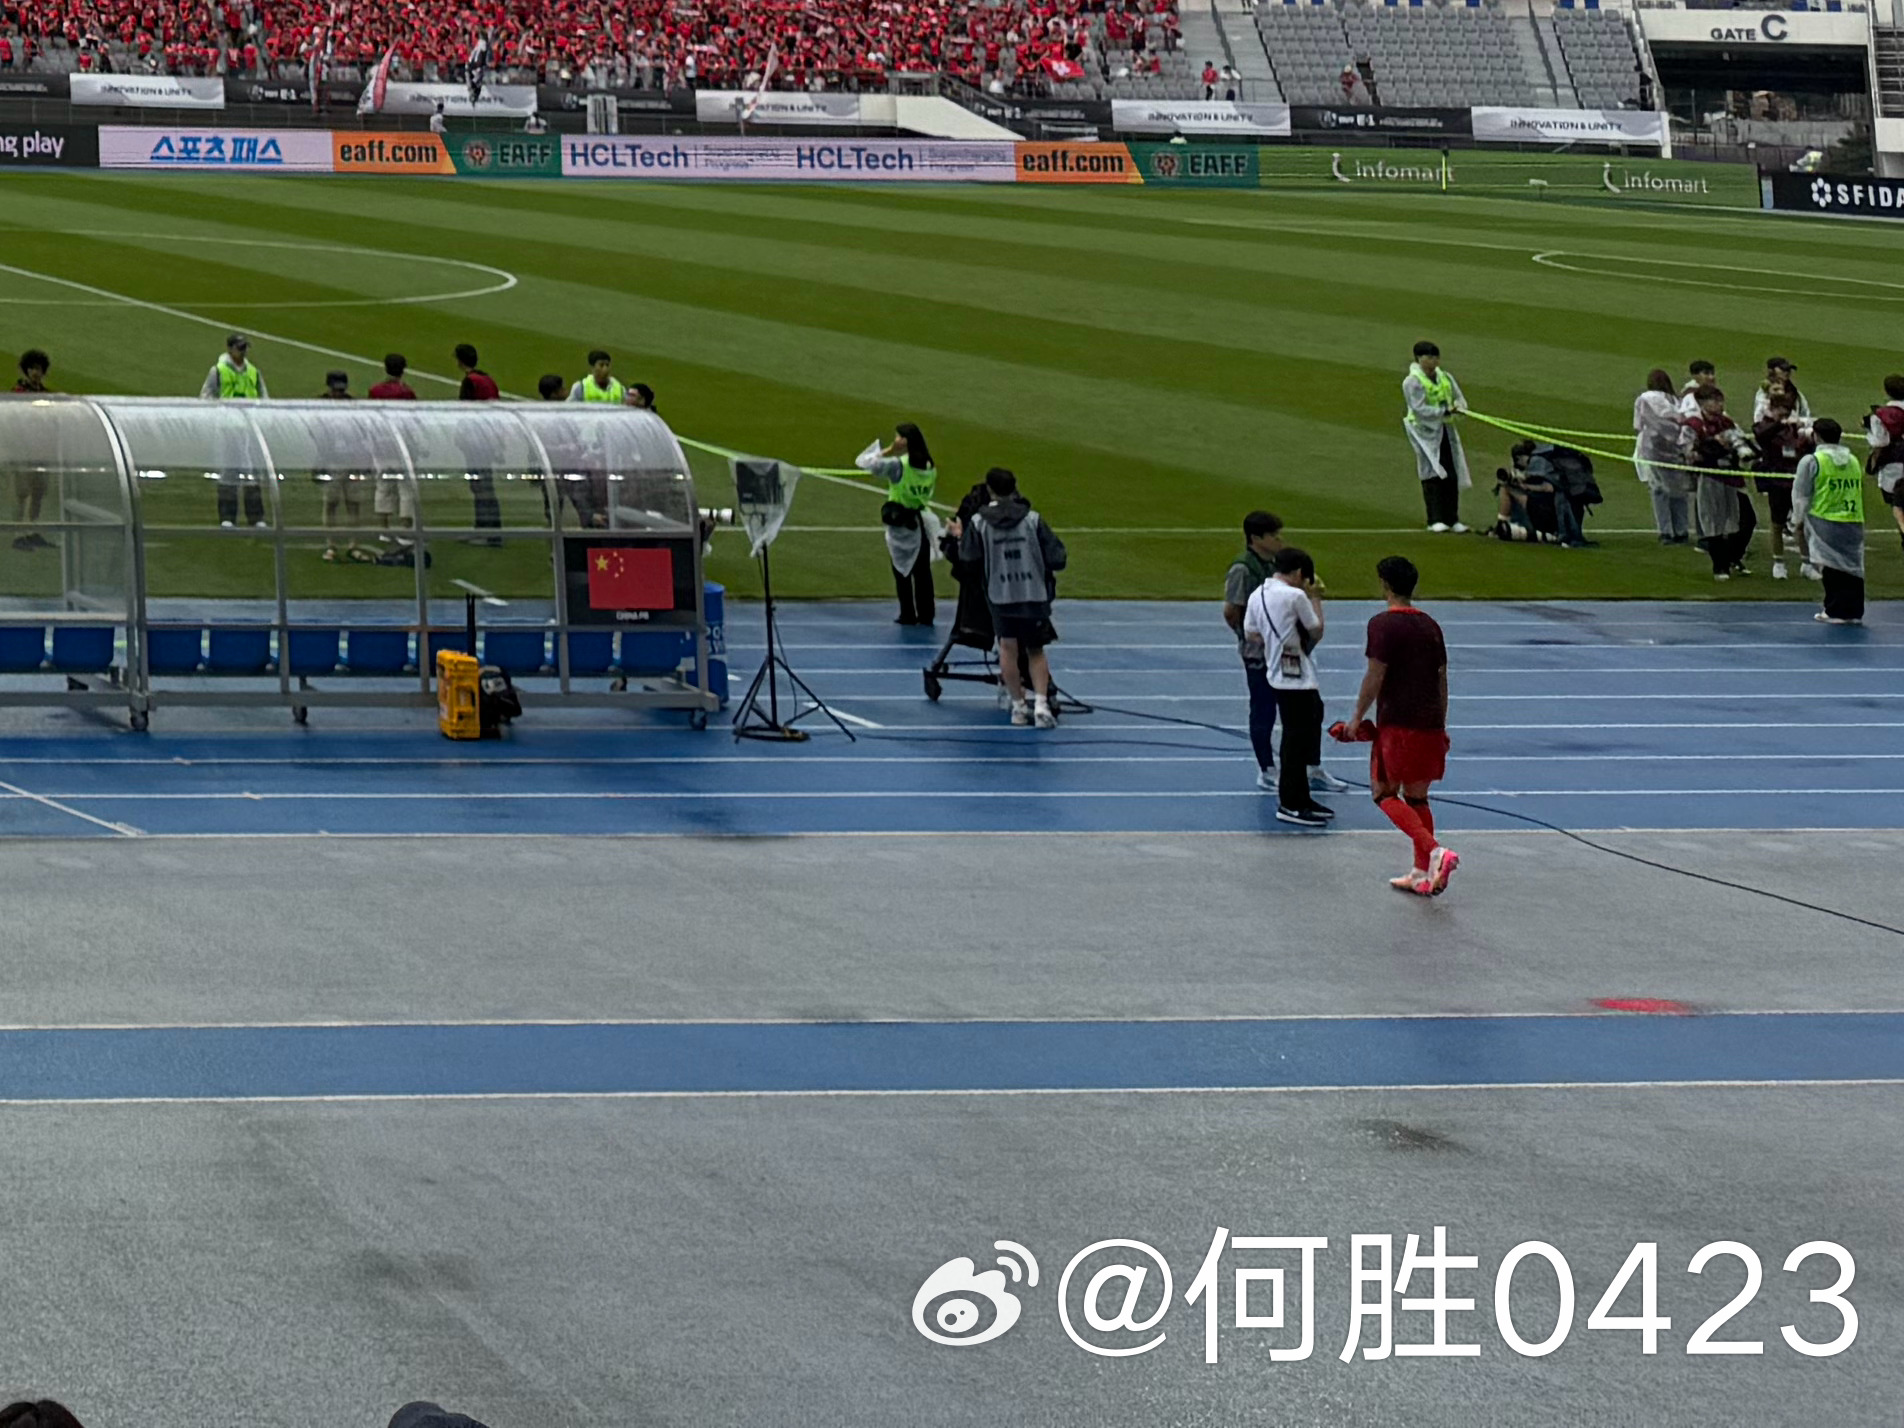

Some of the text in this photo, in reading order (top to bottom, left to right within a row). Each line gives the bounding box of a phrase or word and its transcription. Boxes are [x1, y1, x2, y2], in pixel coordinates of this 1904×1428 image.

[1711, 14, 1788, 42] GATE C
[23, 131, 64, 159] play
[340, 141, 437, 165] eaff.com
[500, 144, 551, 167] EAFF
[571, 144, 688, 168] HCLTech
[797, 146, 913, 171] HCLTech
[1023, 151, 1123, 173] eaff.com
[1189, 153, 1247, 175] EAFF
[1625, 171, 1709, 195] infomart
